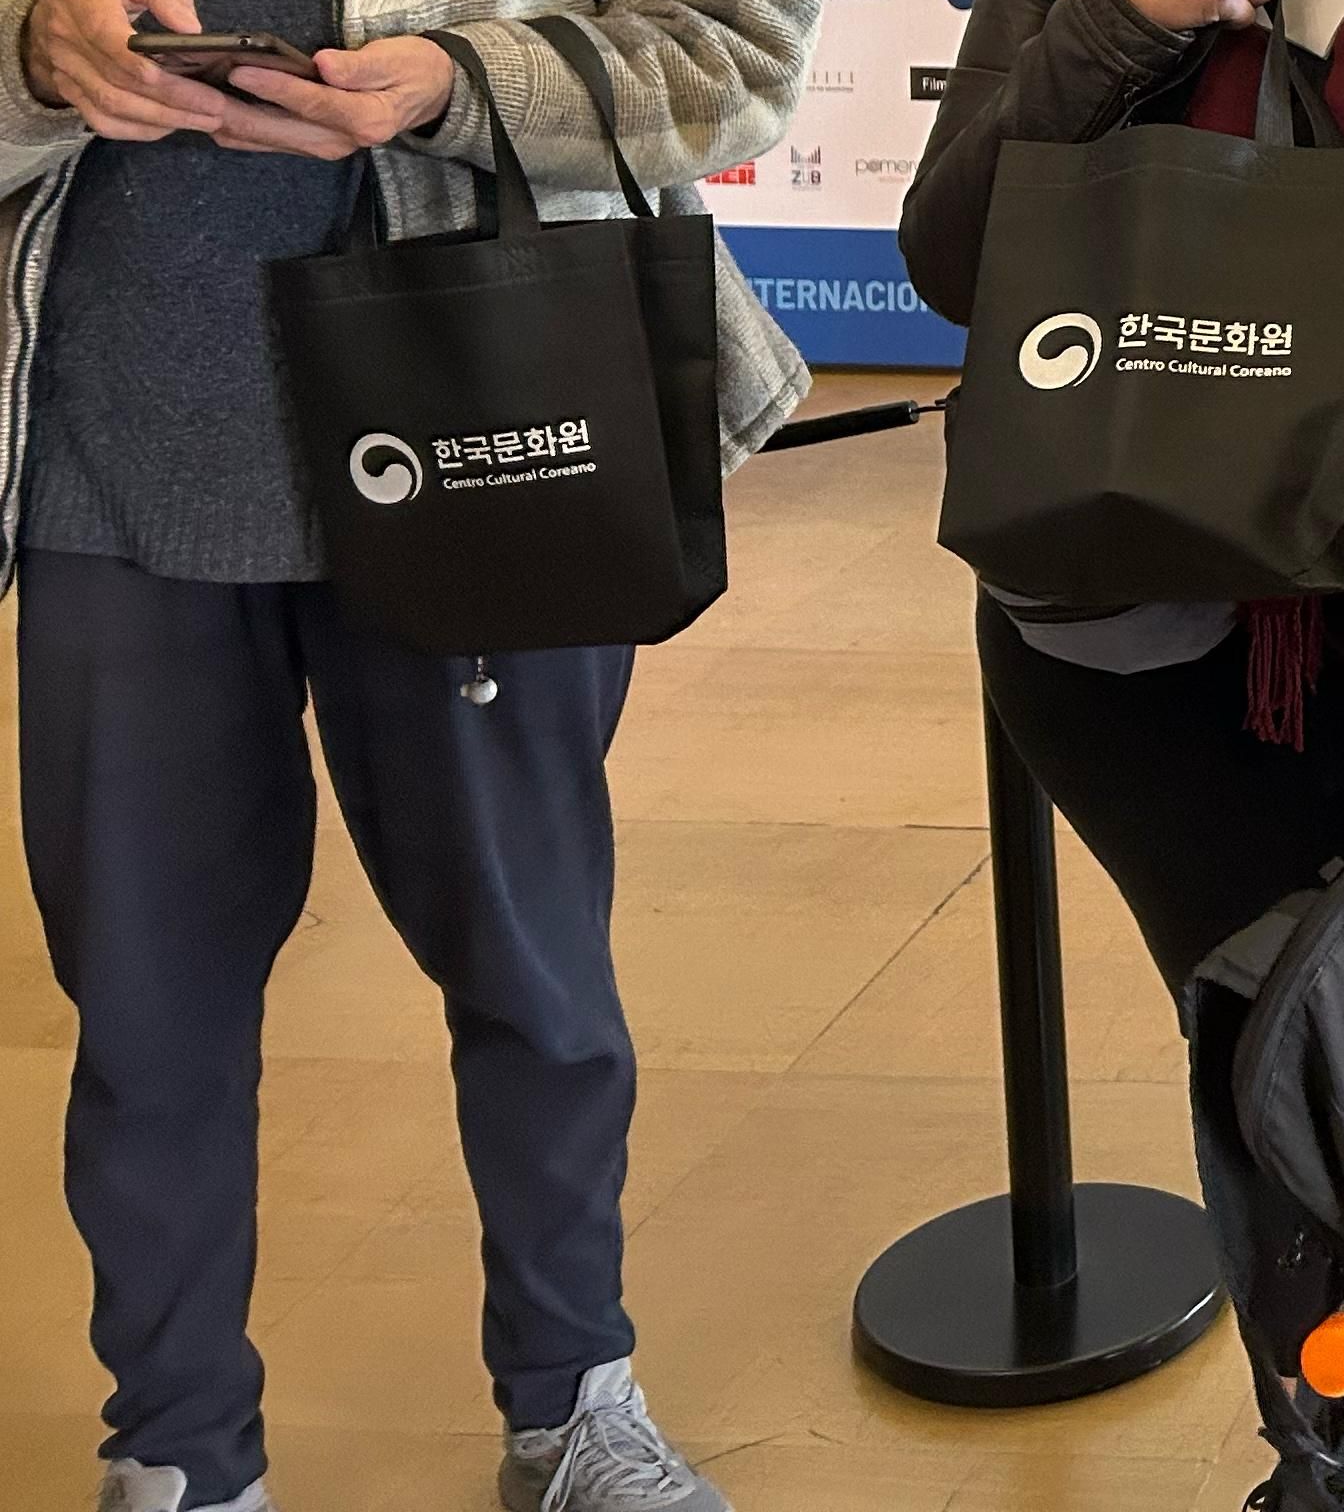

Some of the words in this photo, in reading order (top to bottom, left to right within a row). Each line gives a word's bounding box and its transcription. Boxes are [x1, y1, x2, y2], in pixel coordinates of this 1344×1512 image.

[745, 277, 929, 312] TERNACIO
[1118, 313, 1293, 356] 한국문화원
[1116, 358, 1165, 372] Centro
[1169, 359, 1227, 376] Cultural
[1229, 365, 1292, 378] Coreano
[432, 419, 591, 469] 한국문화원
[443, 477, 484, 490] Centro
[486, 468, 537, 486] Cultural
[539, 461, 597, 479] Coreano
